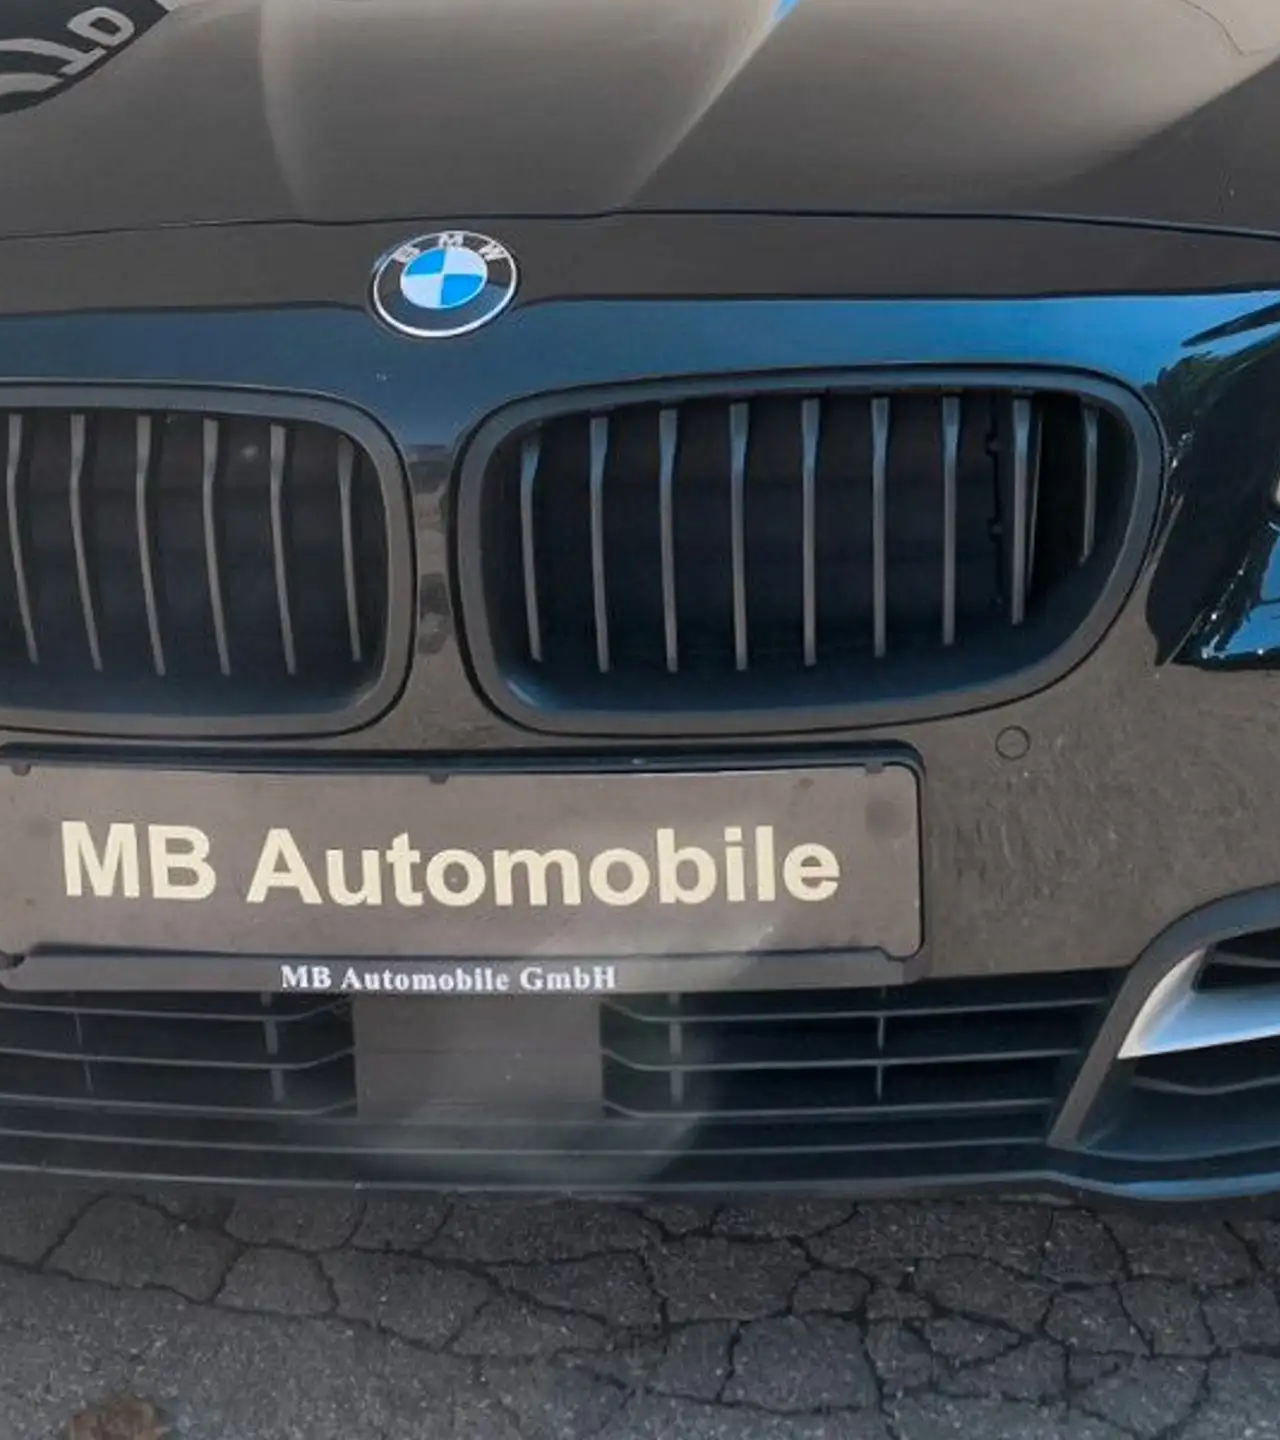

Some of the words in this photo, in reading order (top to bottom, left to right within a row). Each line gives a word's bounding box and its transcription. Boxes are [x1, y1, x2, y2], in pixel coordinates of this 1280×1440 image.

[392, 233, 508, 263] BMW
[61, 820, 218, 900] MB
[245, 825, 841, 907] Automobile
[280, 965, 333, 989] MB
[340, 966, 510, 991] Automobile
[520, 965, 617, 991] GmbH
